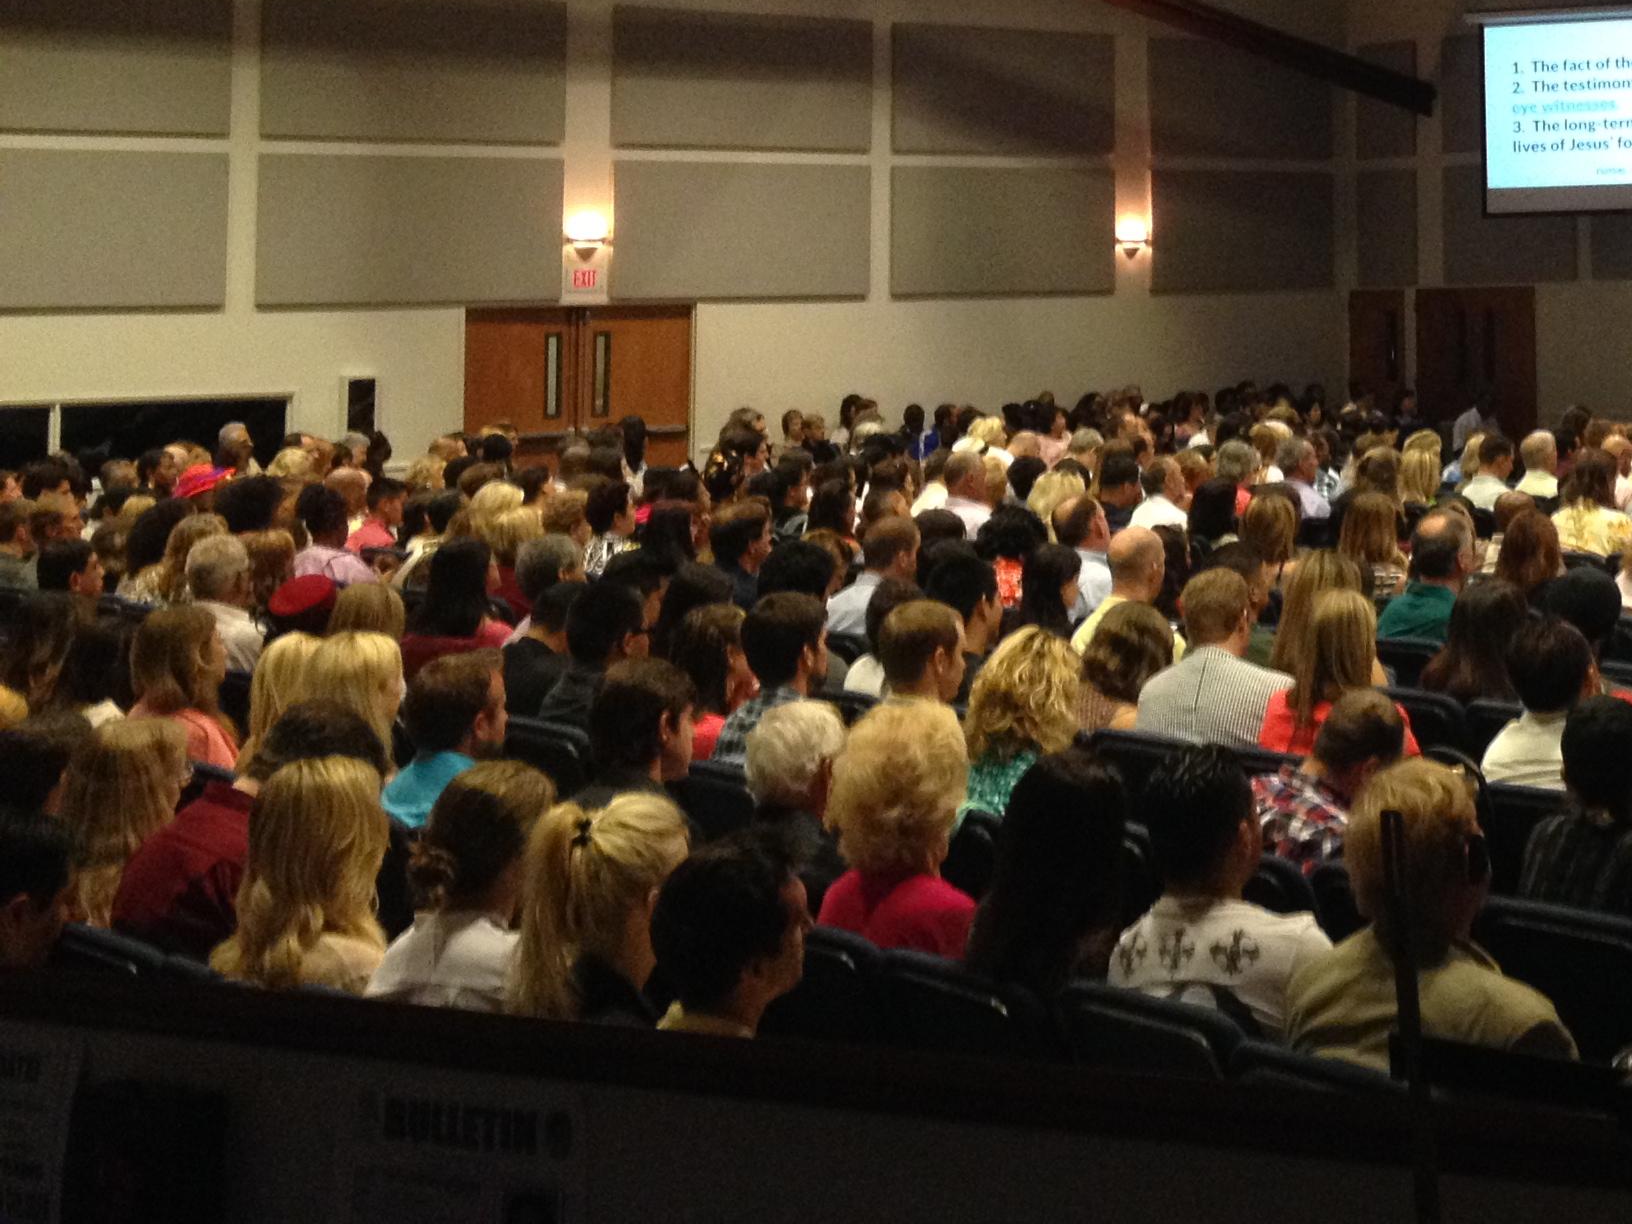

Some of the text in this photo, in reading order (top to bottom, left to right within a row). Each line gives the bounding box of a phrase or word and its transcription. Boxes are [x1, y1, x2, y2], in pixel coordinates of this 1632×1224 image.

[1512, 61, 1525, 75] 1.
[1531, 59, 1560, 73] The
[1563, 58, 1591, 72] fact
[1595, 57, 1610, 70] of
[1512, 81, 1525, 94] 2.
[1531, 79, 1560, 93] The
[1512, 103, 1537, 116] eye
[1512, 120, 1525, 134] 3.
[1532, 119, 1560, 133] The
[1512, 139, 1546, 153] lives
[1550, 138, 1565, 152] of
[1569, 136, 1613, 151] Jesus'
[574, 270, 596, 288] EXIT
[384, 1096, 538, 1156] BULLETIN
